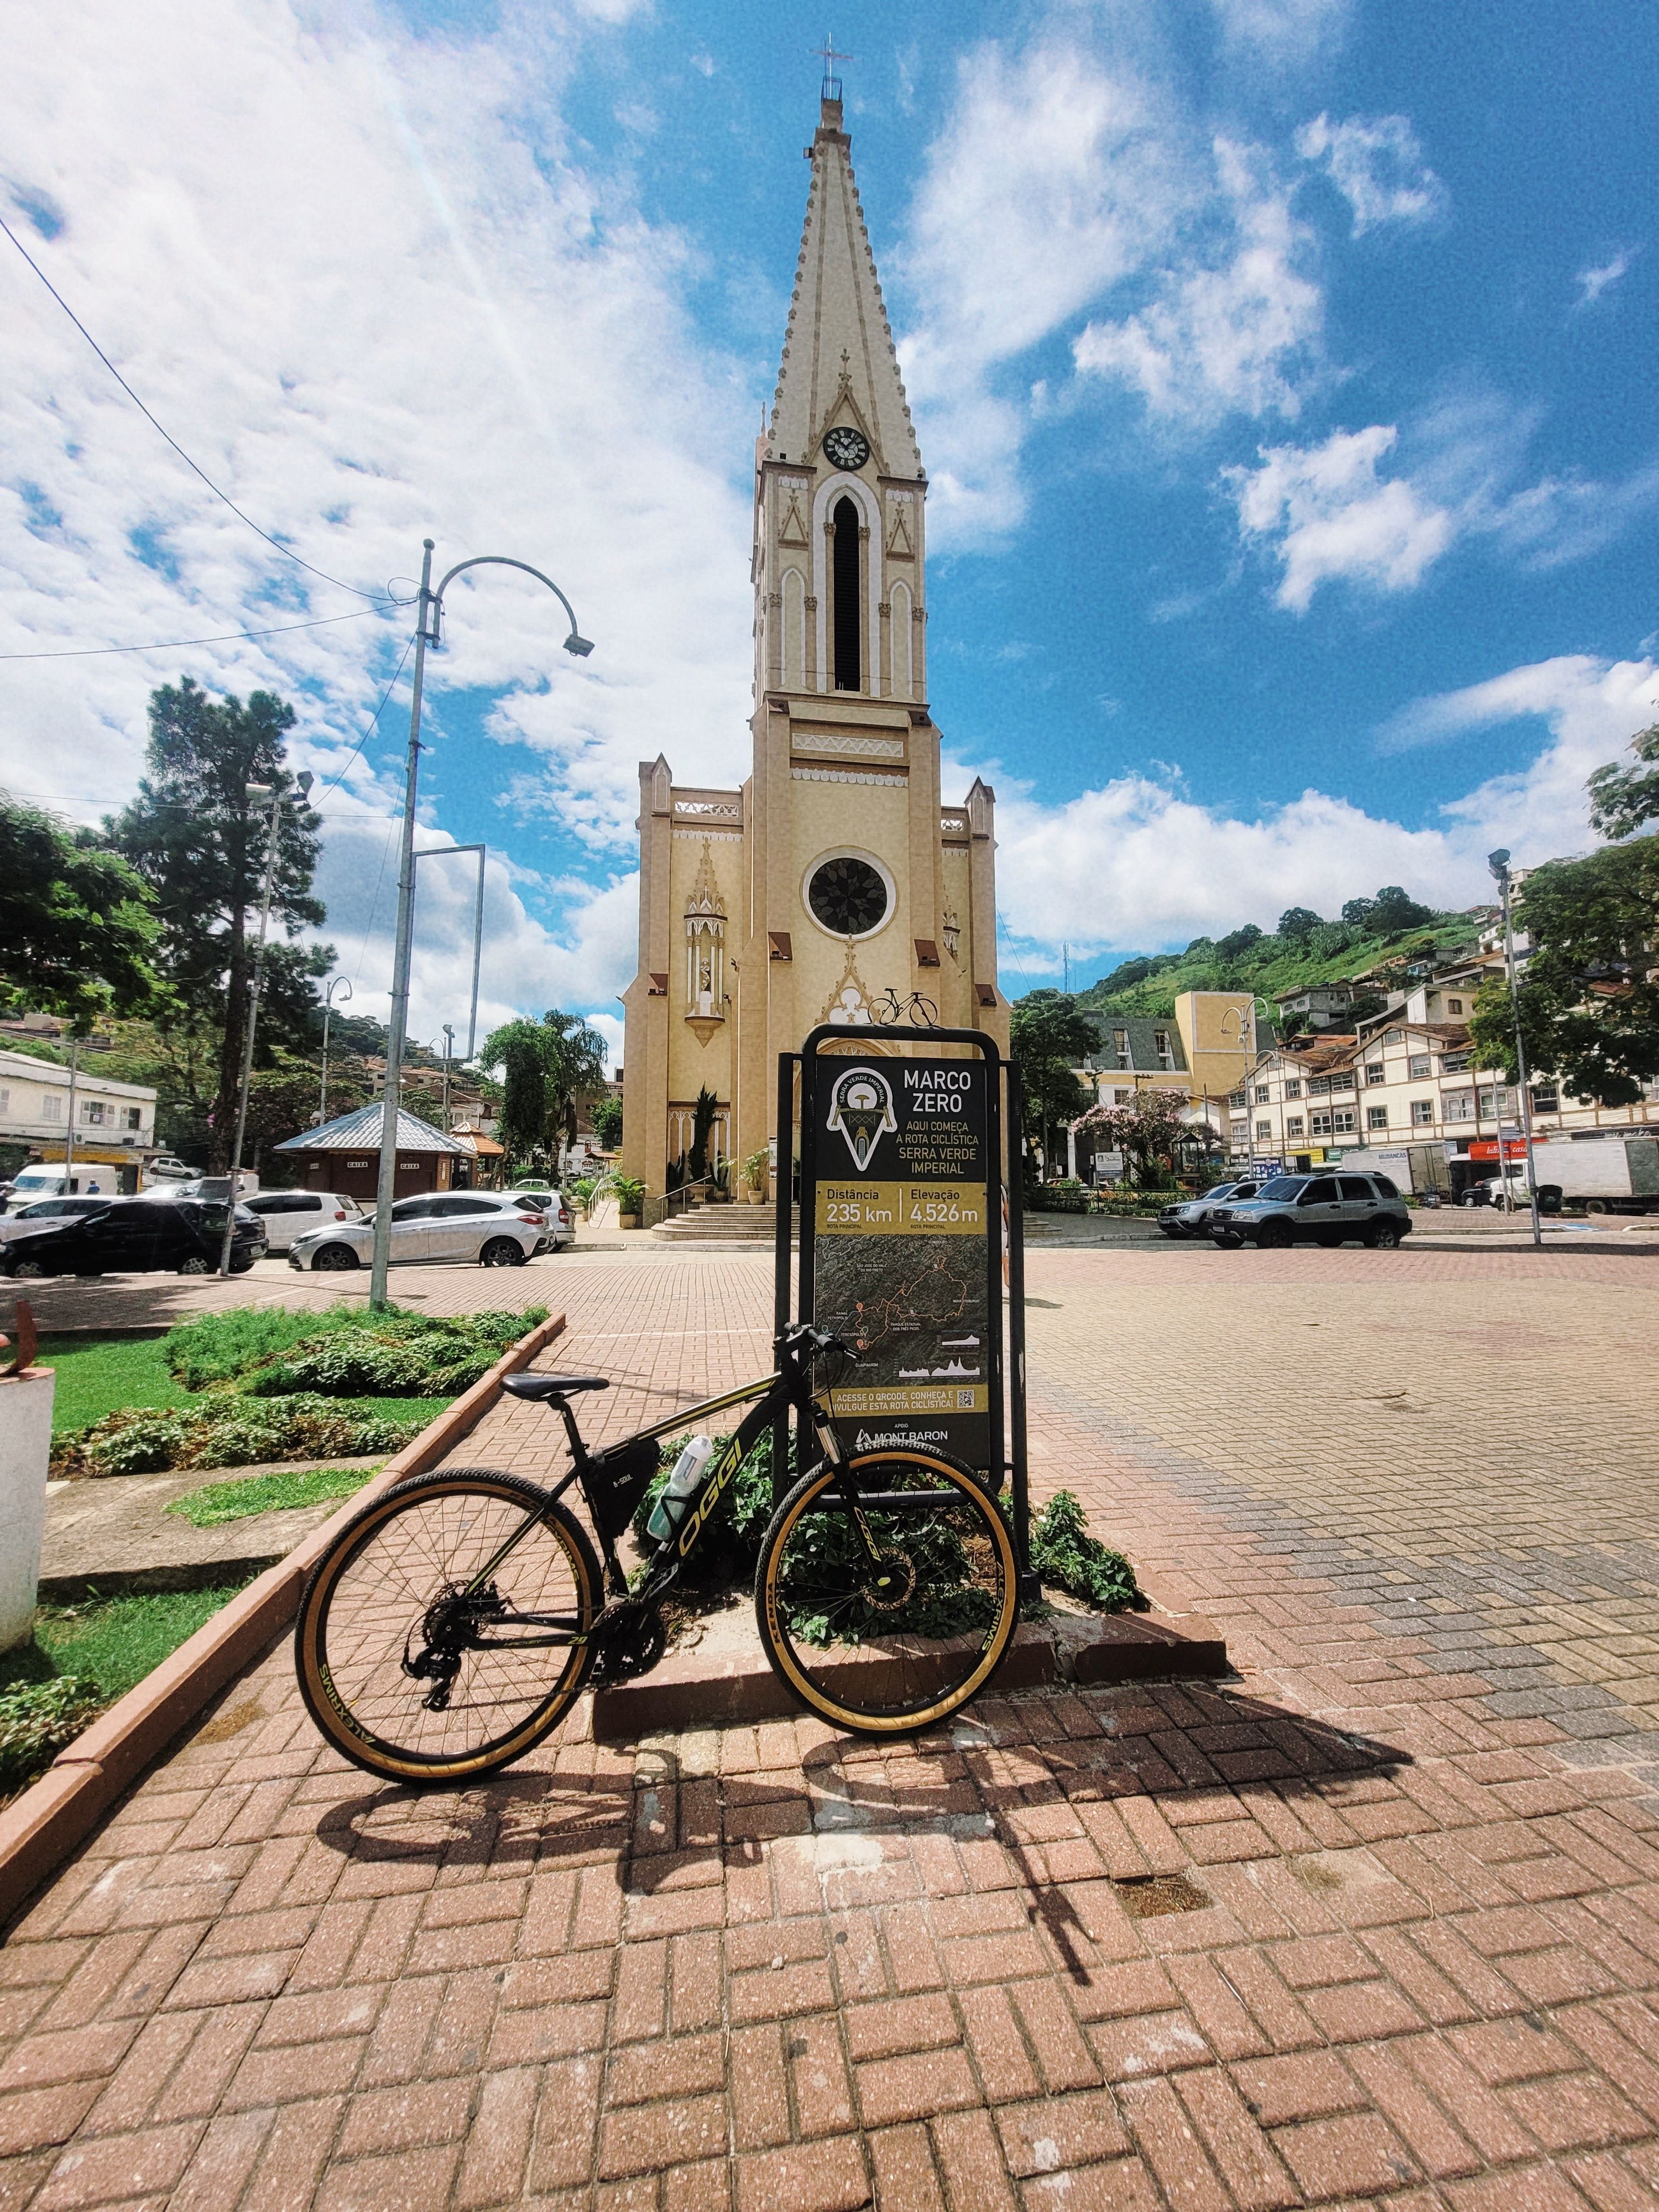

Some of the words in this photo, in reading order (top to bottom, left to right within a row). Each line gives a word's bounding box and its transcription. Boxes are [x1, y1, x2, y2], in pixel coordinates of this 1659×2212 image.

[904, 1070, 971, 1090] MARCO
[840, 1083, 849, 1103] SERRA
[847, 1076, 868, 1084] VERDE
[868, 1077, 885, 1103] IMPERIAL
[912, 1093, 962, 1113] ZERO
[906, 1120, 928, 1130] AQUI
[931, 1121, 968, 1134] COMEÇA
[896, 1134, 902, 1144] A
[905, 1134, 928, 1144] ROTA
[931, 1133, 979, 1145] CICLÍSTICA
[899, 1147, 937, 1159] SERRA
[940, 1148, 976, 1160] VERDE
[912, 1162, 964, 1173] IMPERIAL
[827, 1189, 879, 1199] Distância
[911, 1189, 959, 1202] Elevação
[827, 1203, 860, 1222] 235
[865, 1206, 891, 1222] km
[910, 1203, 959, 1222] 4.526
[962, 1210, 978, 1222] m
[837, 1394, 867, 1402] ACESSE
[876, 1392, 908, 1401] QRCODE,
[910, 1391, 947, 1401] CONHEÇA
[869, 1402, 888, 1410] ESTA
[911, 1399, 953, 1409] CICLÍSTICA!
[874, 1432, 907, 1441] MONT
[909, 1431, 948, 1441] BARON
[613, 1474, 633, 1488] B-SOUL
[679, 1437, 742, 1557] OGGI
[854, 1506, 881, 1562] OGGI
[768, 1583, 780, 1644] KENDA
[982, 1561, 1004, 1652] ALEXRIMS
[567, 1636, 588, 1645] 29
[320, 1663, 377, 1744] ALEXRIMS
